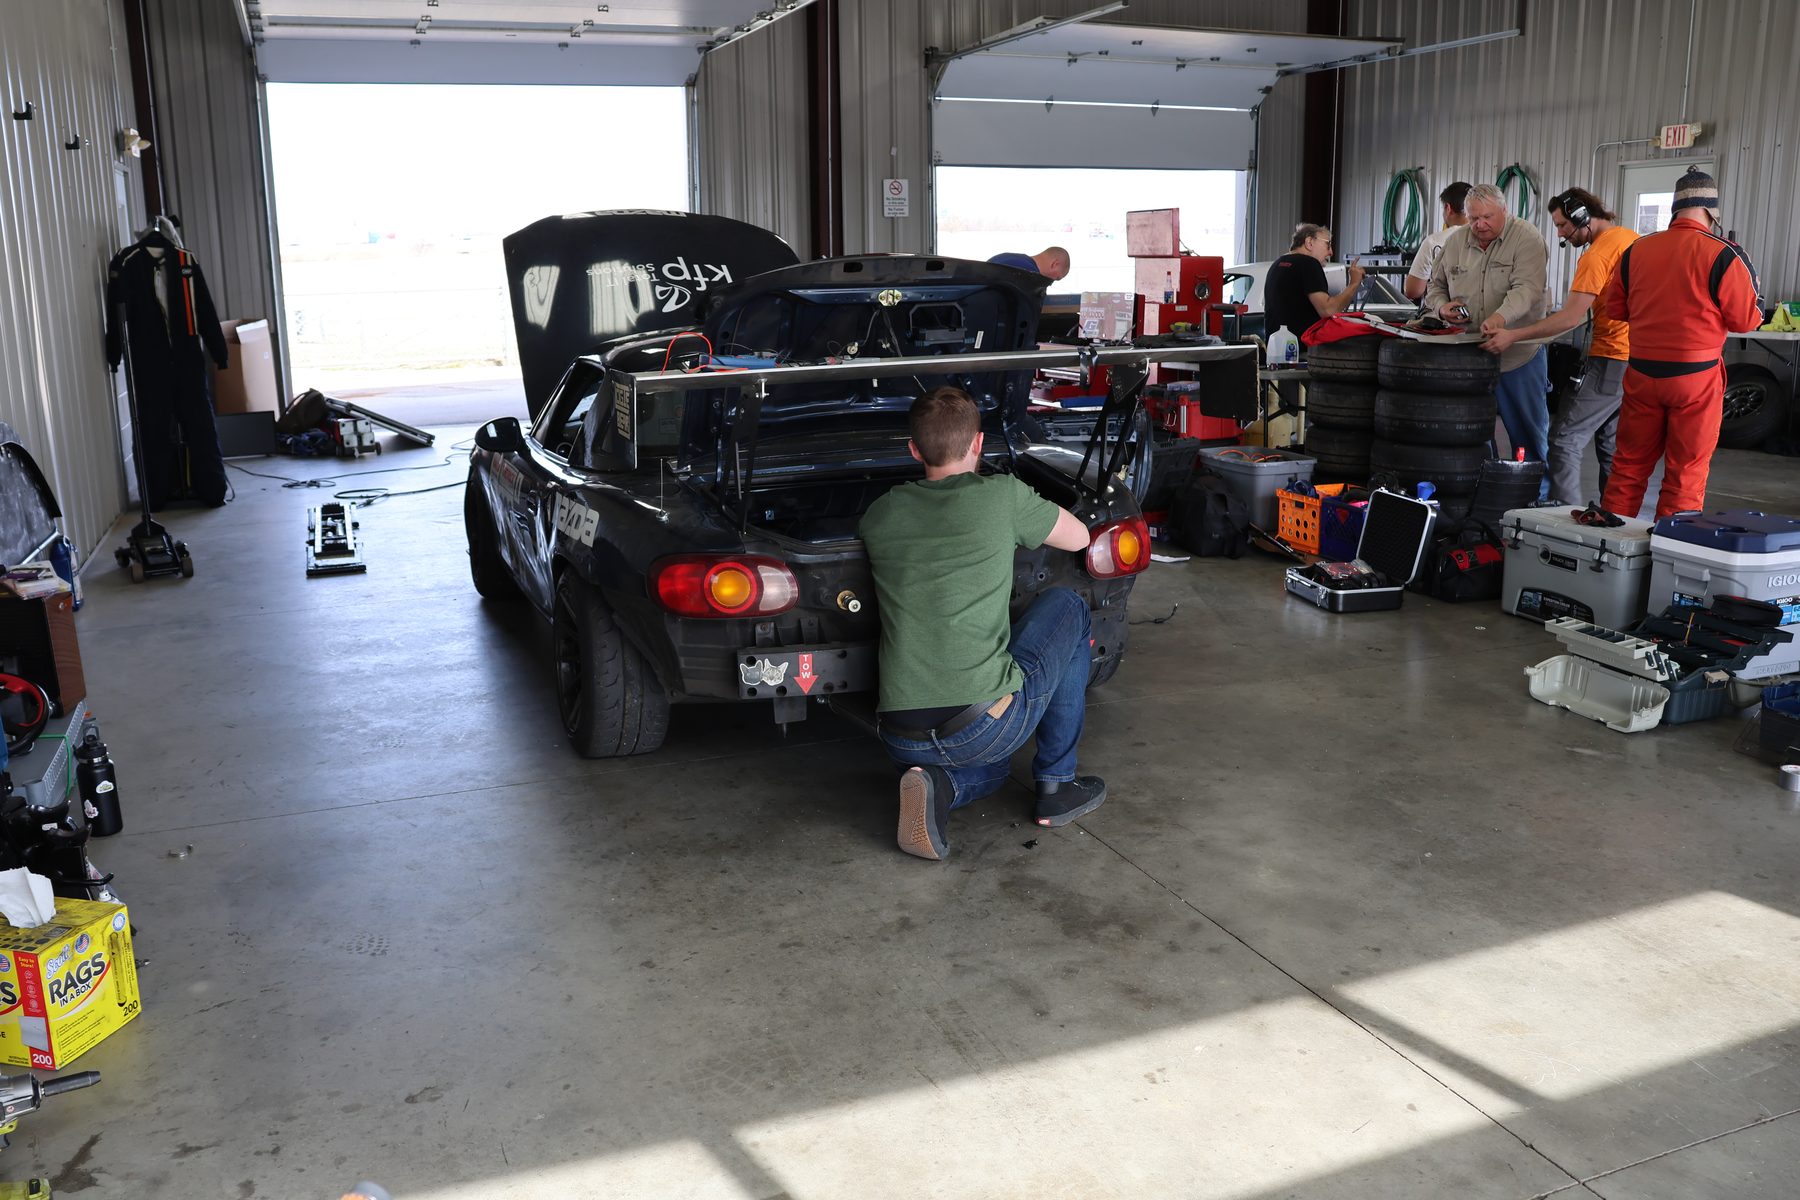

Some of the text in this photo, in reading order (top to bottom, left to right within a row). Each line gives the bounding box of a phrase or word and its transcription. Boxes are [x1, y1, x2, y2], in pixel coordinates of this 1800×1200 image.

[1665, 125, 1687, 147] EXIT
[586, 263, 655, 277] Solutions
[623, 273, 660, 286] Total
[661, 256, 733, 291] kfp
[801, 654, 811, 679] TOW
[48, 952, 106, 1004] RAGS
[60, 982, 92, 1007] IN A BOX
[123, 1000, 139, 1017] 200
[32, 1053, 53, 1066] 200
